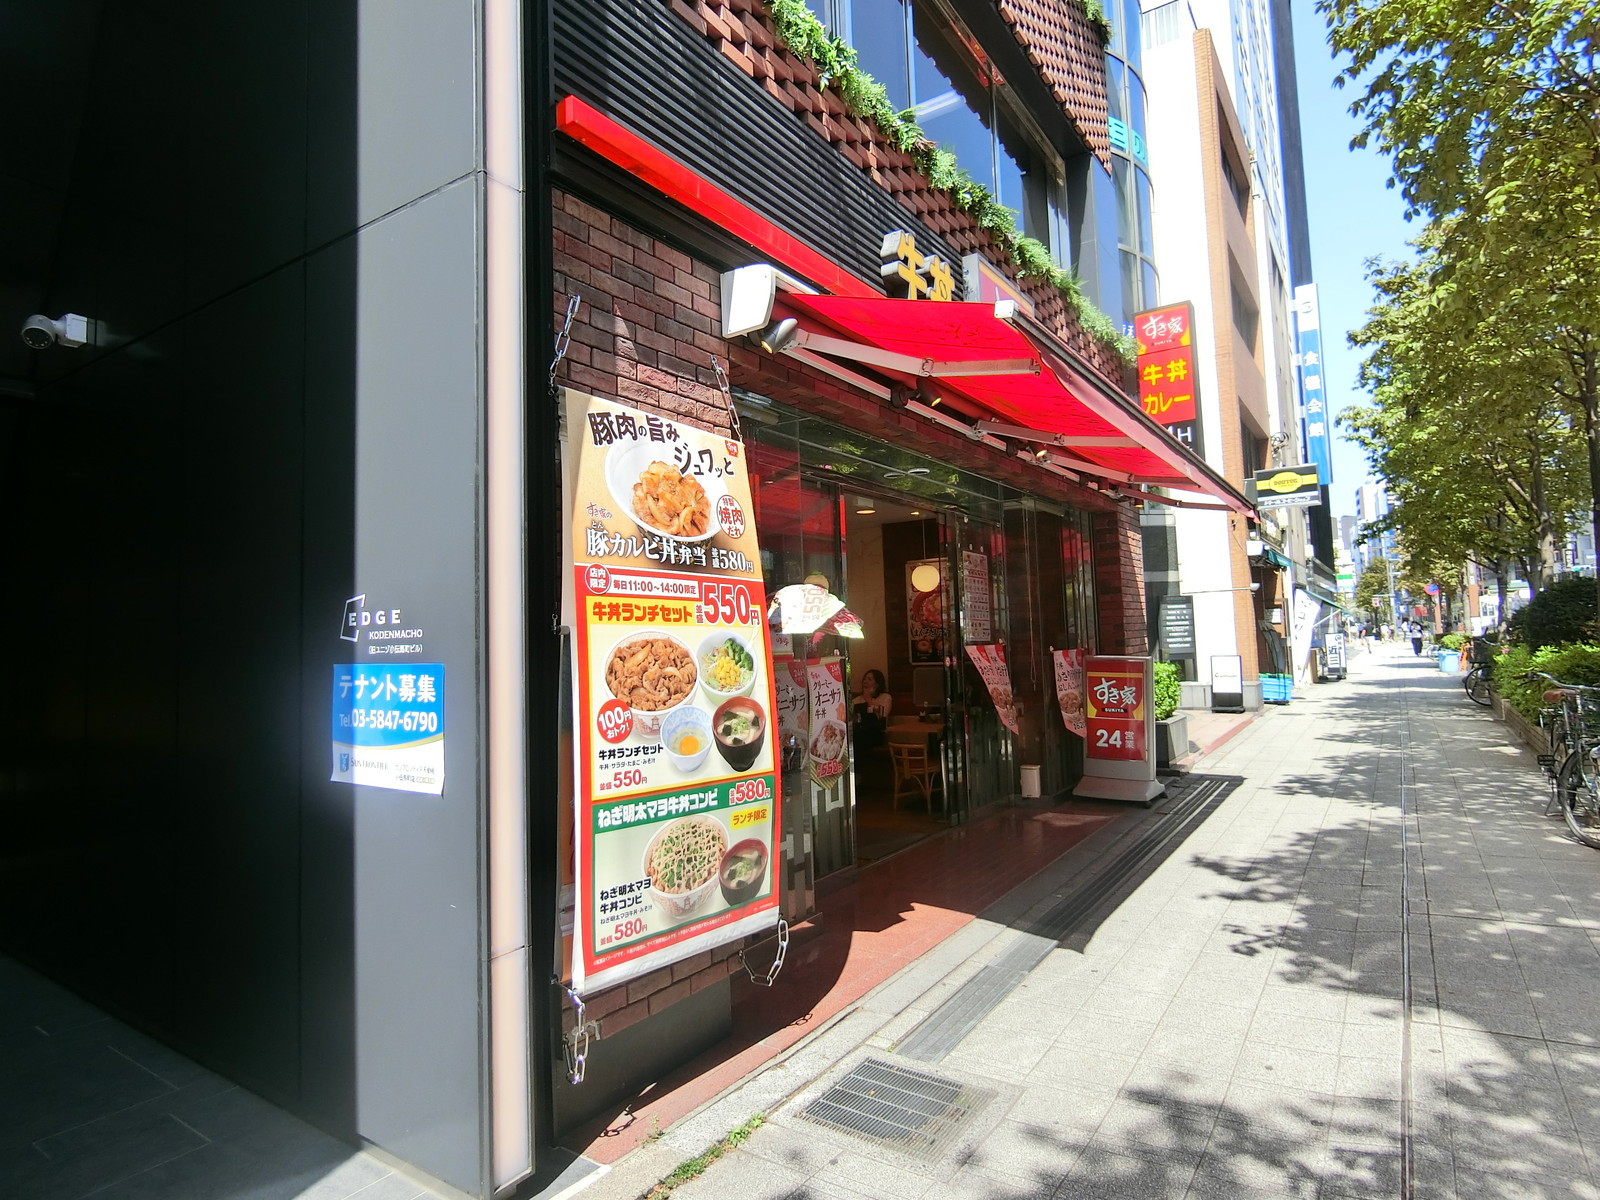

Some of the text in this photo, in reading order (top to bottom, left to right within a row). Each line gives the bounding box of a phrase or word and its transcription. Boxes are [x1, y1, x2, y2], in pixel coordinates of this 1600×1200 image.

[887, 231, 955, 302] 牛丼
[1142, 315, 1184, 339] すき家
[1143, 358, 1188, 386] 牛丼
[1144, 391, 1191, 415] カレー
[587, 411, 680, 446] 豚肉の旨み
[673, 443, 735, 478] ジュワッと
[718, 506, 744, 526] 焼肉
[726, 525, 742, 537] だれ
[586, 529, 707, 567] 豚カルビ丼弁当
[589, 567, 606, 577] 店内
[589, 578, 606, 588] 限定
[592, 602, 692, 623] 牛丼ランチセット
[369, 629, 423, 640] KODENMACHO
[339, 674, 436, 703] テナント募集
[1093, 677, 1137, 708] すき家
[599, 706, 632, 729] 100円
[1096, 729, 1122, 748] 24
[598, 743, 664, 760] 牛丼ランチセット
[597, 788, 718, 828] ねぎ明太マヨ牛丼コンビ
[732, 808, 768, 825] ランチ限定
[600, 878, 651, 901] ねぎ明太マヨ
[600, 895, 643, 914] 牛丼コンビ
